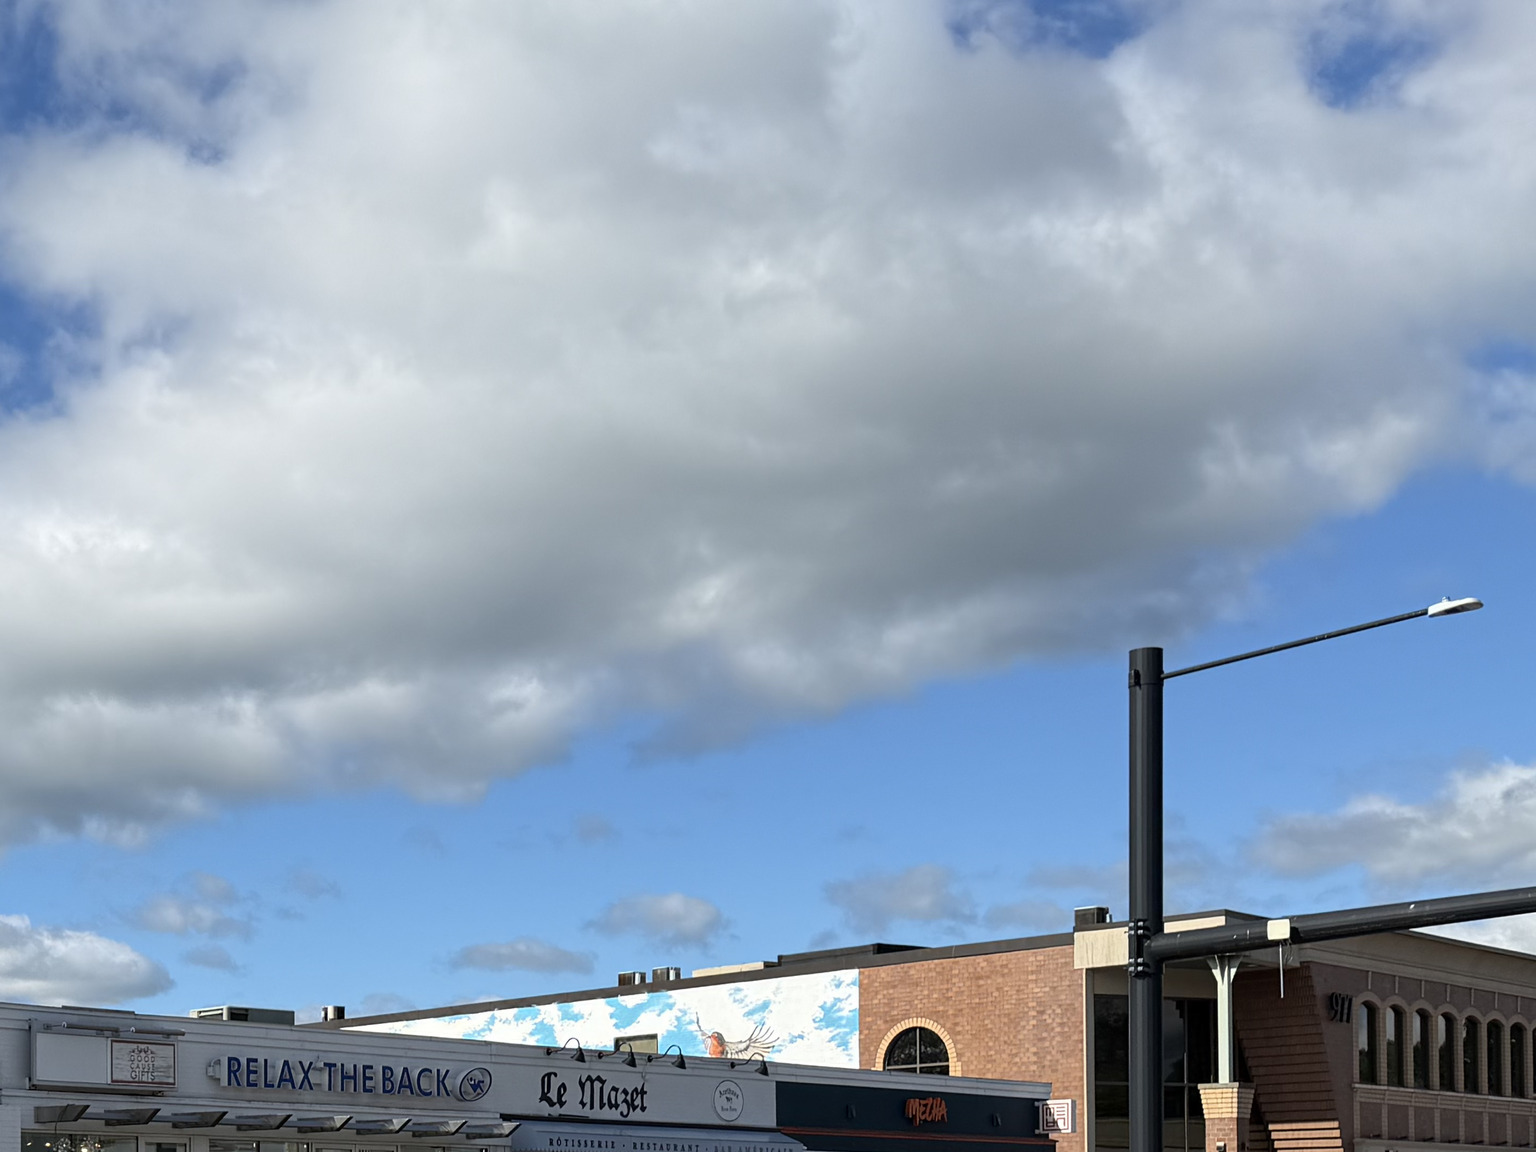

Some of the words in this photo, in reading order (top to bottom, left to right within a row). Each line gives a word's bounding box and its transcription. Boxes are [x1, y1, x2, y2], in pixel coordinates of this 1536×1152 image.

[130, 1054, 156, 1063] GOOD
[130, 1062, 155, 1071] CAUSE
[130, 1070, 156, 1081] GIFTS
[227, 1056, 314, 1091] RELAX
[323, 1062, 374, 1094] THE
[381, 1065, 451, 1097] BACK
[539, 1071, 567, 1109] Le
[578, 1074, 648, 1118] Mazet
[905, 1097, 948, 1127] MECHA
[549, 1136, 616, 1149] RÔTISSERIE
[633, 1141, 700, 1152] RESTAURANT
